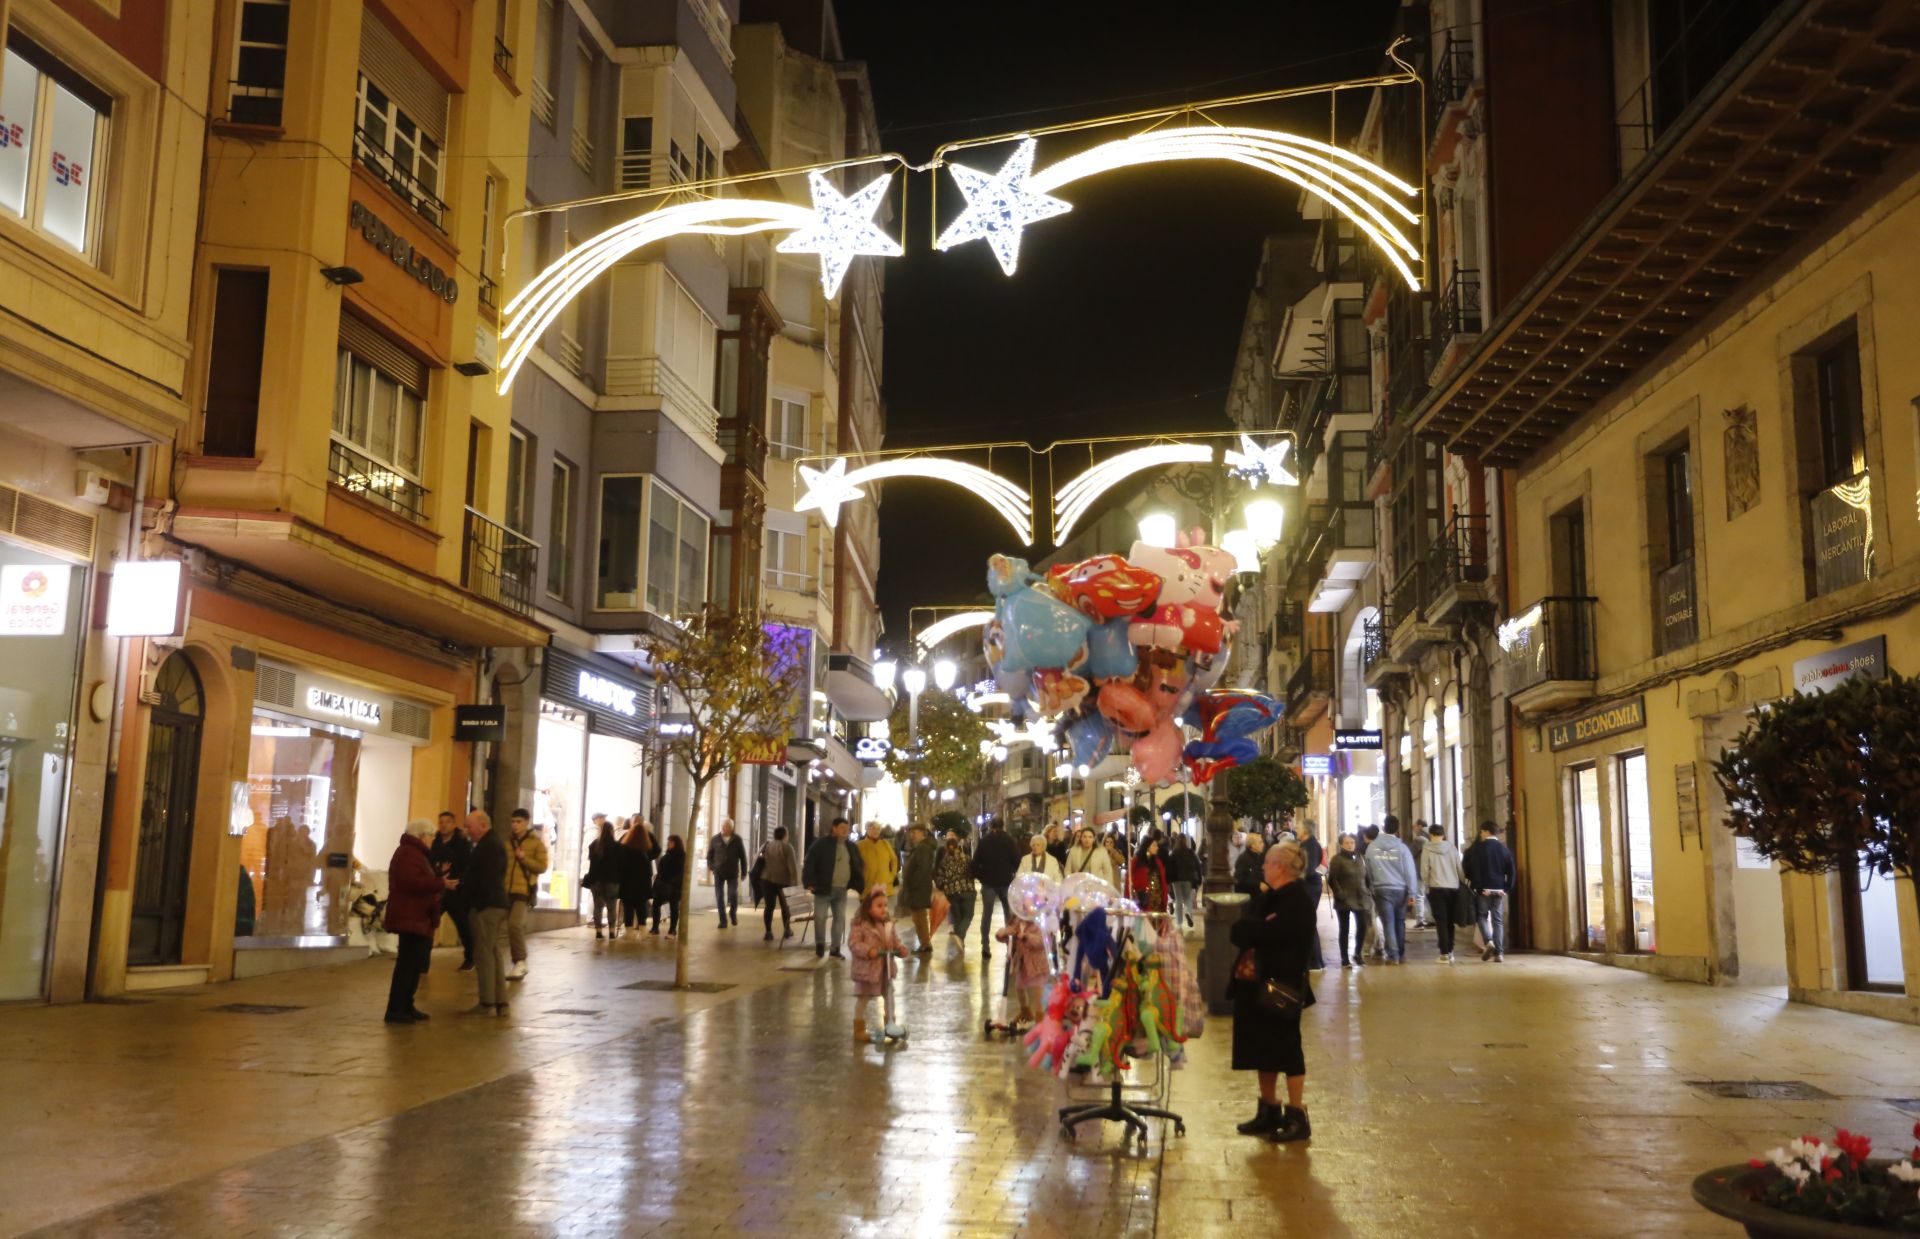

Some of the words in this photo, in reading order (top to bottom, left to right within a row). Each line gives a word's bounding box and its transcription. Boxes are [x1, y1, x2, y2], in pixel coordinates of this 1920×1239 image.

[1824, 511, 1858, 537] LABORAL
[1821, 536, 1864, 561] MERCANTIL
[1669, 590, 1688, 605] FISCAL
[1665, 606, 1693, 626] CONTABLE
[1553, 726, 1569, 746] LA
[1575, 703, 1640, 740] ECONOMIA
